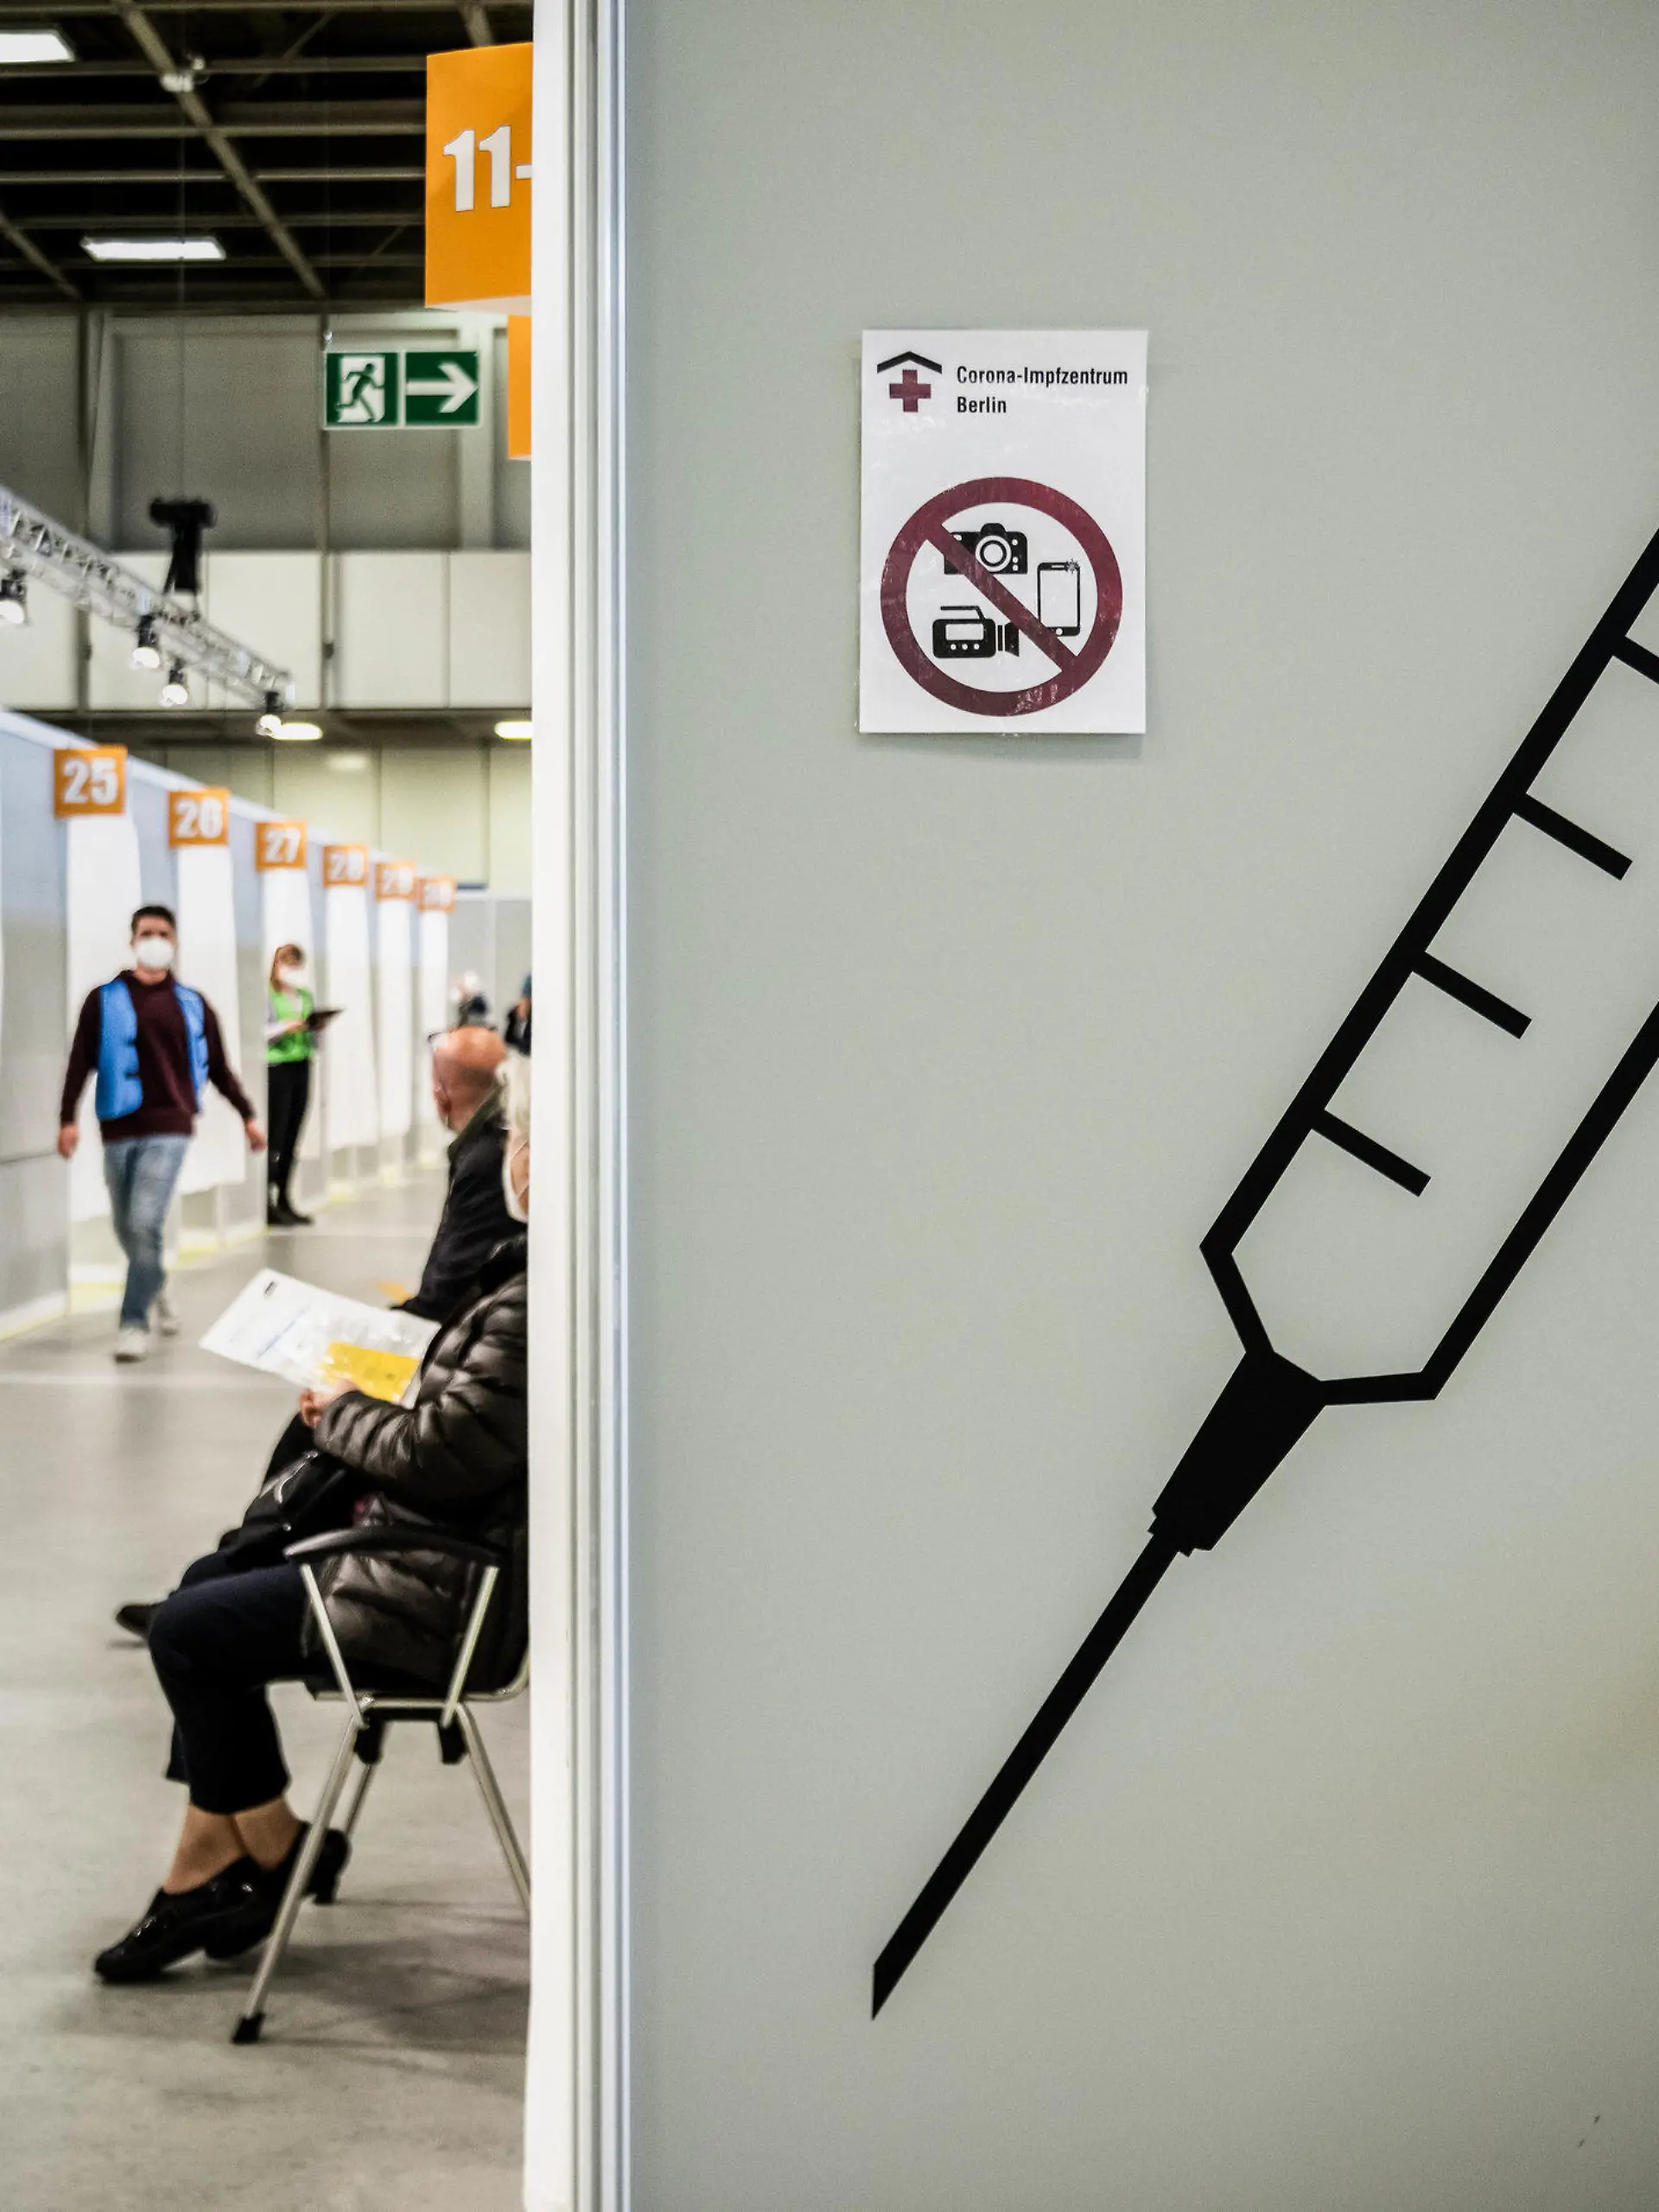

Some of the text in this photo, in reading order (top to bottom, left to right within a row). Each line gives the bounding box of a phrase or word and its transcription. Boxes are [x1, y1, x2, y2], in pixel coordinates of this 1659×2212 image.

[957, 366, 1128, 387] Corona-Impfzentrum
[957, 397, 1007, 414] Berlin
[63, 757, 118, 804] 25
[265, 827, 302, 863] 27
